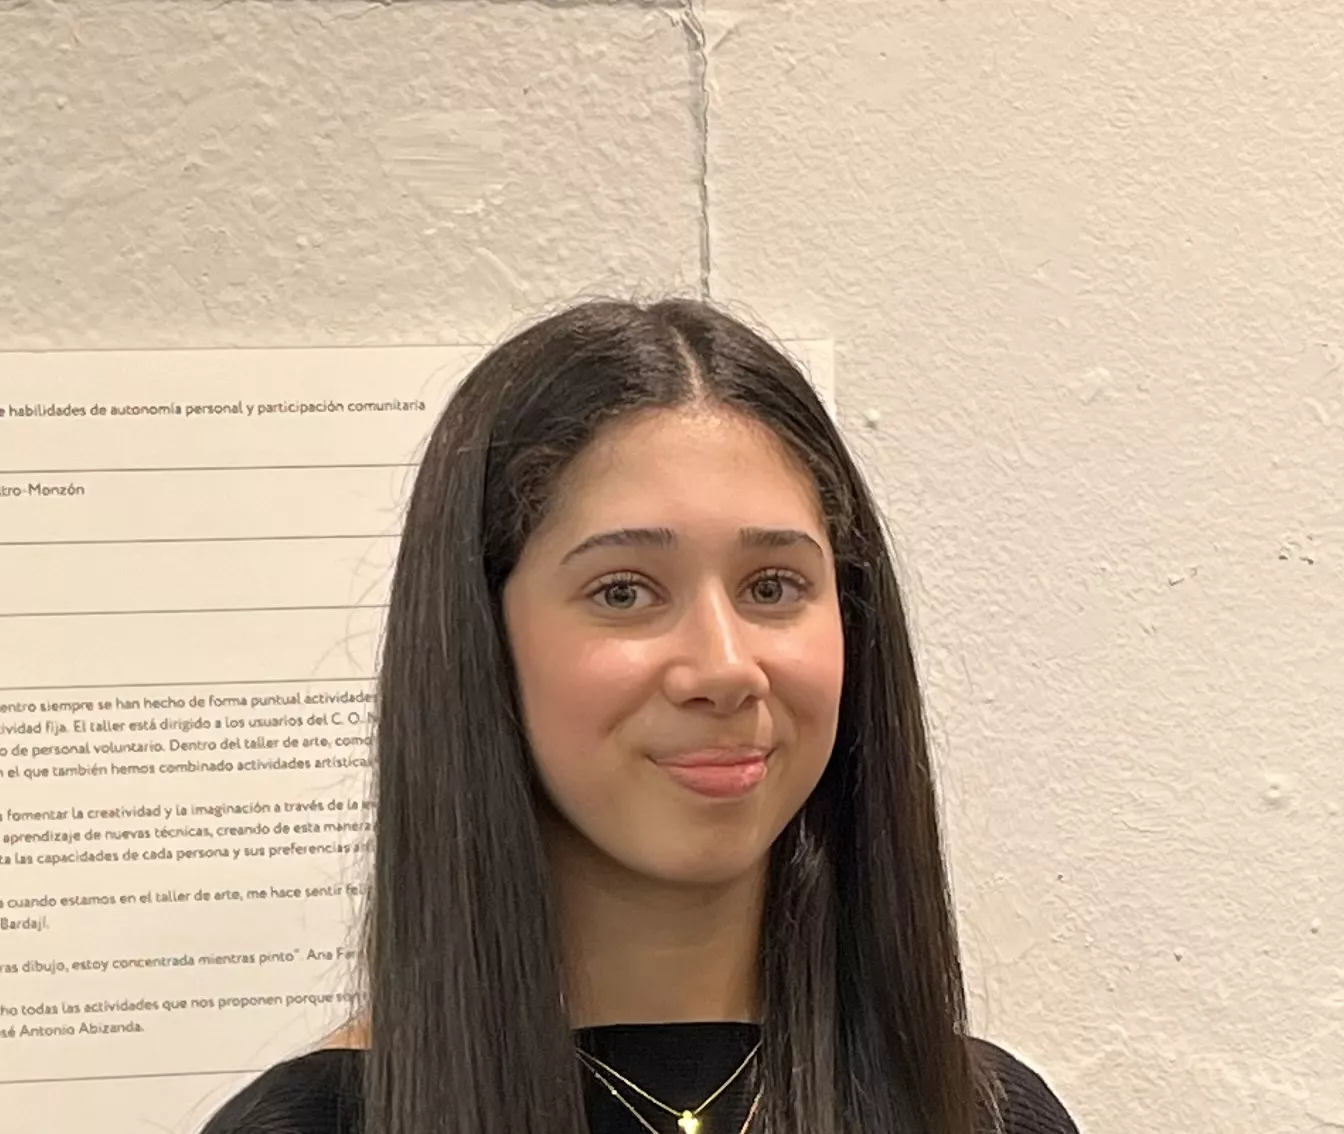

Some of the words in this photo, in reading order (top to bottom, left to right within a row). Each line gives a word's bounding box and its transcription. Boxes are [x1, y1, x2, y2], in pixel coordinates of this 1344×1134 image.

[9, 403, 86, 417] habilidades
[90, 403, 107, 416] de
[110, 402, 182, 416] autonomía
[185, 400, 243, 418] personal
[246, 404, 255, 417] y
[258, 400, 344, 416] participación
[348, 399, 426, 412] comunitaria
[40, 701, 94, 714] siempre
[98, 701, 112, 711] se
[116, 697, 140, 710] han
[144, 696, 185, 709] hecho
[189, 695, 205, 709] de
[209, 694, 248, 707] forma
[251, 692, 302, 709] puntual
[73, 719, 86, 733] El
[90, 719, 126, 733] taller
[128, 717, 157, 732] está
[159, 717, 211, 733] dirigido
[215, 720, 222, 729] a
[225, 716, 245, 729] los
[248, 714, 303, 728] usuarios
[306, 712, 328, 726] del
[11, 744, 28, 757] de
[32, 742, 91, 759] personal
[169, 738, 217, 752] Dentro
[220, 737, 241, 751] del
[244, 736, 280, 750] taller
[283, 736, 299, 749] de
[7, 808, 68, 822] fomentar
[72, 807, 84, 820] la
[87, 804, 161, 819] creatividad
[164, 807, 172, 820] y
[176, 805, 187, 816] la
[191, 801, 271, 818] imaginación
[274, 803, 281, 814] a
[284, 799, 324, 813] través
[327, 798, 344, 811] de
[347, 798, 361, 812] la
[2, 830, 80, 846] aprendizaje
[84, 828, 102, 841] de
[105, 829, 151, 840] nuevas
[216, 822, 270, 837] creando
[273, 821, 290, 835] de
[293, 823, 321, 833] esta
[7, 894, 57, 909] cuando
[60, 895, 116, 907] estamos
[120, 894, 136, 904] en
[139, 890, 152, 904] el
[155, 890, 191, 903] taller
[193, 889, 211, 902] de
[247, 889, 267, 899] me
[270, 886, 301, 899] hace
[305, 885, 342, 897] sentir
[0, 915, 49, 932] Bardají.
[72, 960, 109, 973] estoy
[112, 954, 195, 969] concentrada
[198, 954, 255, 965] mientras
[307, 948, 333, 960] Ana
[21, 1002, 58, 1016] todas
[62, 1002, 81, 1014] las
[84, 998, 159, 1013] actividades
[162, 1000, 187, 1012] que
[191, 998, 215, 1009] nos
[218, 996, 283, 1010] proponen
[286, 993, 333, 1007] porque
[19, 1024, 75, 1038] Antonio
[79, 1021, 144, 1035] Abizanda.
